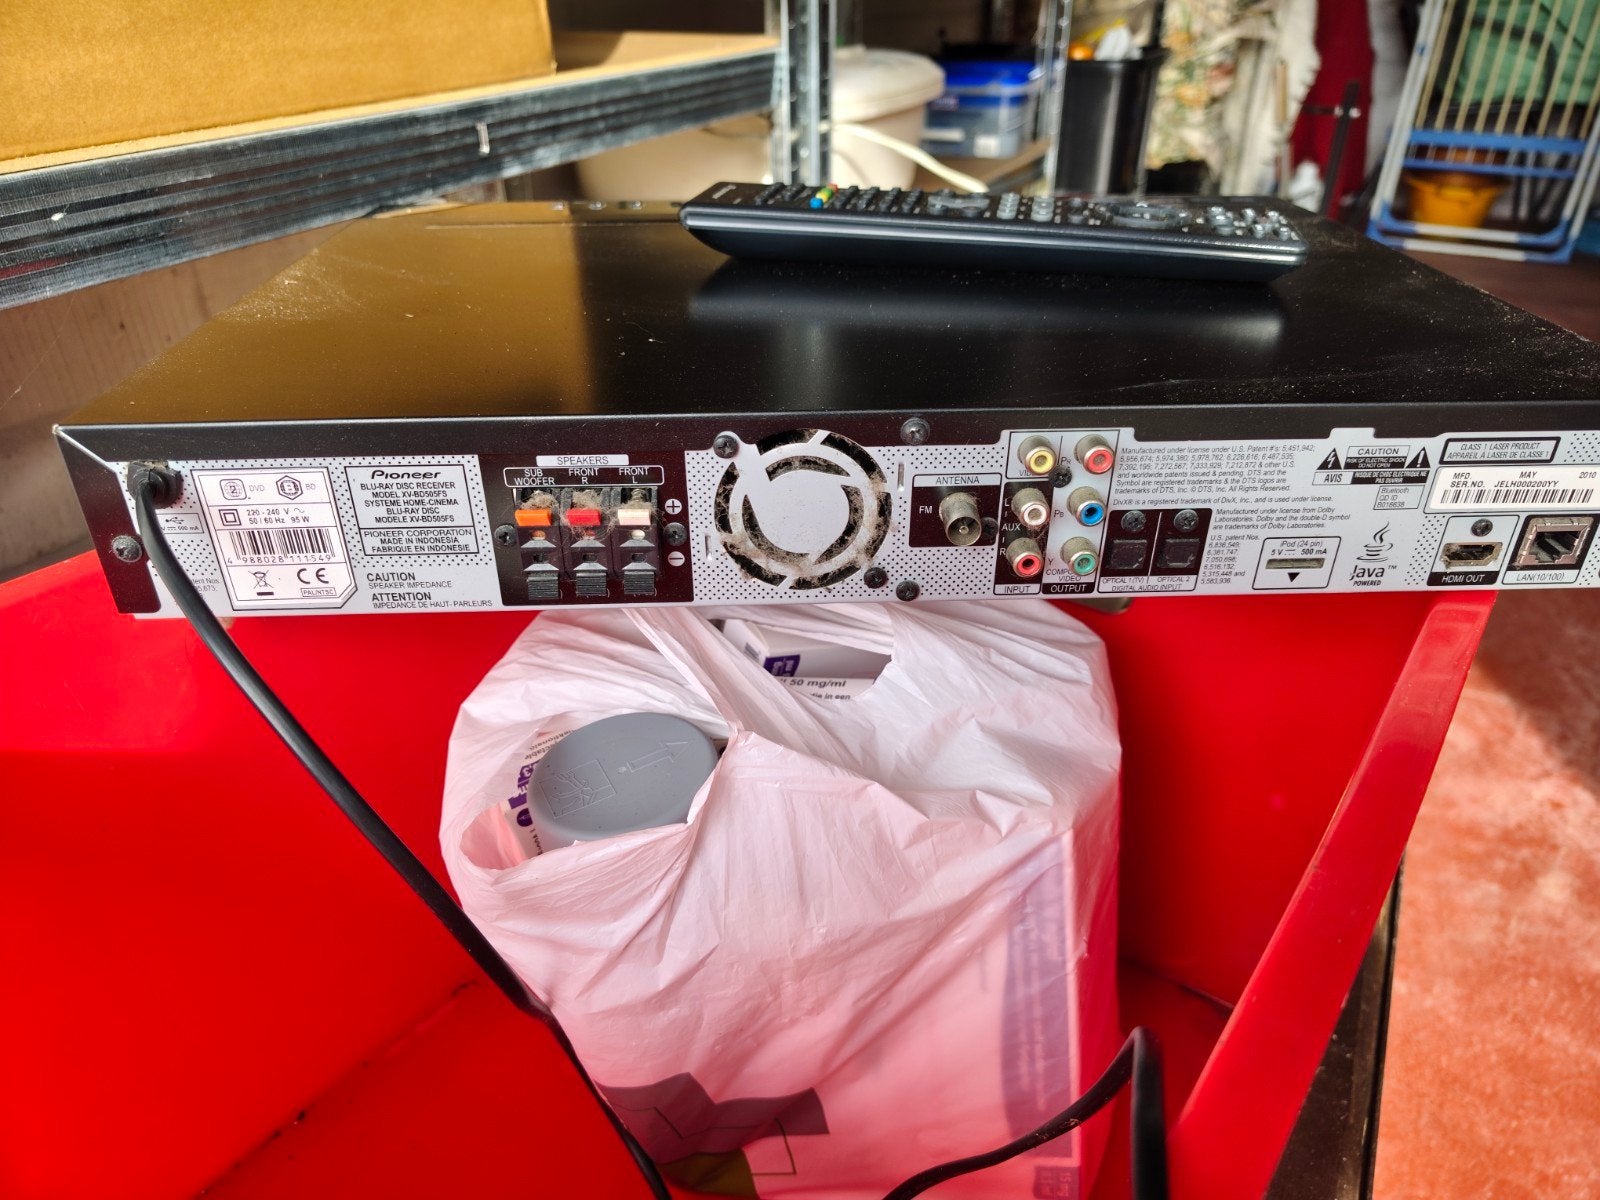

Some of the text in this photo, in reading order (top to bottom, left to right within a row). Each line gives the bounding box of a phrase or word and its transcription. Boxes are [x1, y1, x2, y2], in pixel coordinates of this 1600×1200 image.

[1357, 448, 1400, 456] CAUTION
[1447, 452, 1479, 460] APPAREIL
[1487, 451, 1508, 459] LASER
[1509, 451, 1518, 459] DE
[557, 457, 609, 466] SPEAKERS
[371, 470, 441, 480] Pioneer
[524, 468, 649, 477] SUB FRONT FRONT
[514, 478, 555, 486] WOOFER
[582, 477, 589, 485] R
[936, 476, 980, 485] ANTENNA
[1324, 474, 1343, 483] AVIS
[360, 483, 394, 491] BLU-RAY
[416, 482, 456, 490] RECEIVER
[1153, 480, 1186, 488] registered
[230, 486, 237, 494] 2
[1238, 485, 1259, 493] Rights
[364, 499, 459, 508] SYSTEME HOME-CINEMA
[386, 507, 440, 516] BLU-RAY DISC
[919, 506, 933, 514] FM
[374, 516, 408, 524] MODELE
[1329, 514, 1351, 522] symbol
[1268, 523, 1286, 531] Dolby
[364, 529, 472, 538] PIONEER CORPORATION
[1309, 541, 1323, 549] pin)
[1000, 548, 1006, 556] R
[242, 556, 285, 564] 988028
[297, 568, 329, 584] CE
[366, 572, 416, 582] CAUTION
[1349, 565, 1385, 581] Java
[1516, 572, 1565, 582] LAN(10/100)
[1441, 574, 1485, 583] HDMI OUT
[407, 581, 453, 589] IMPEDANCE
[1050, 585, 1087, 593] OUTPUT
[372, 592, 432, 602] ATTENTION
[453, 600, 493, 608] PARLEURS
[807, 679, 847, 688] mg/ml
